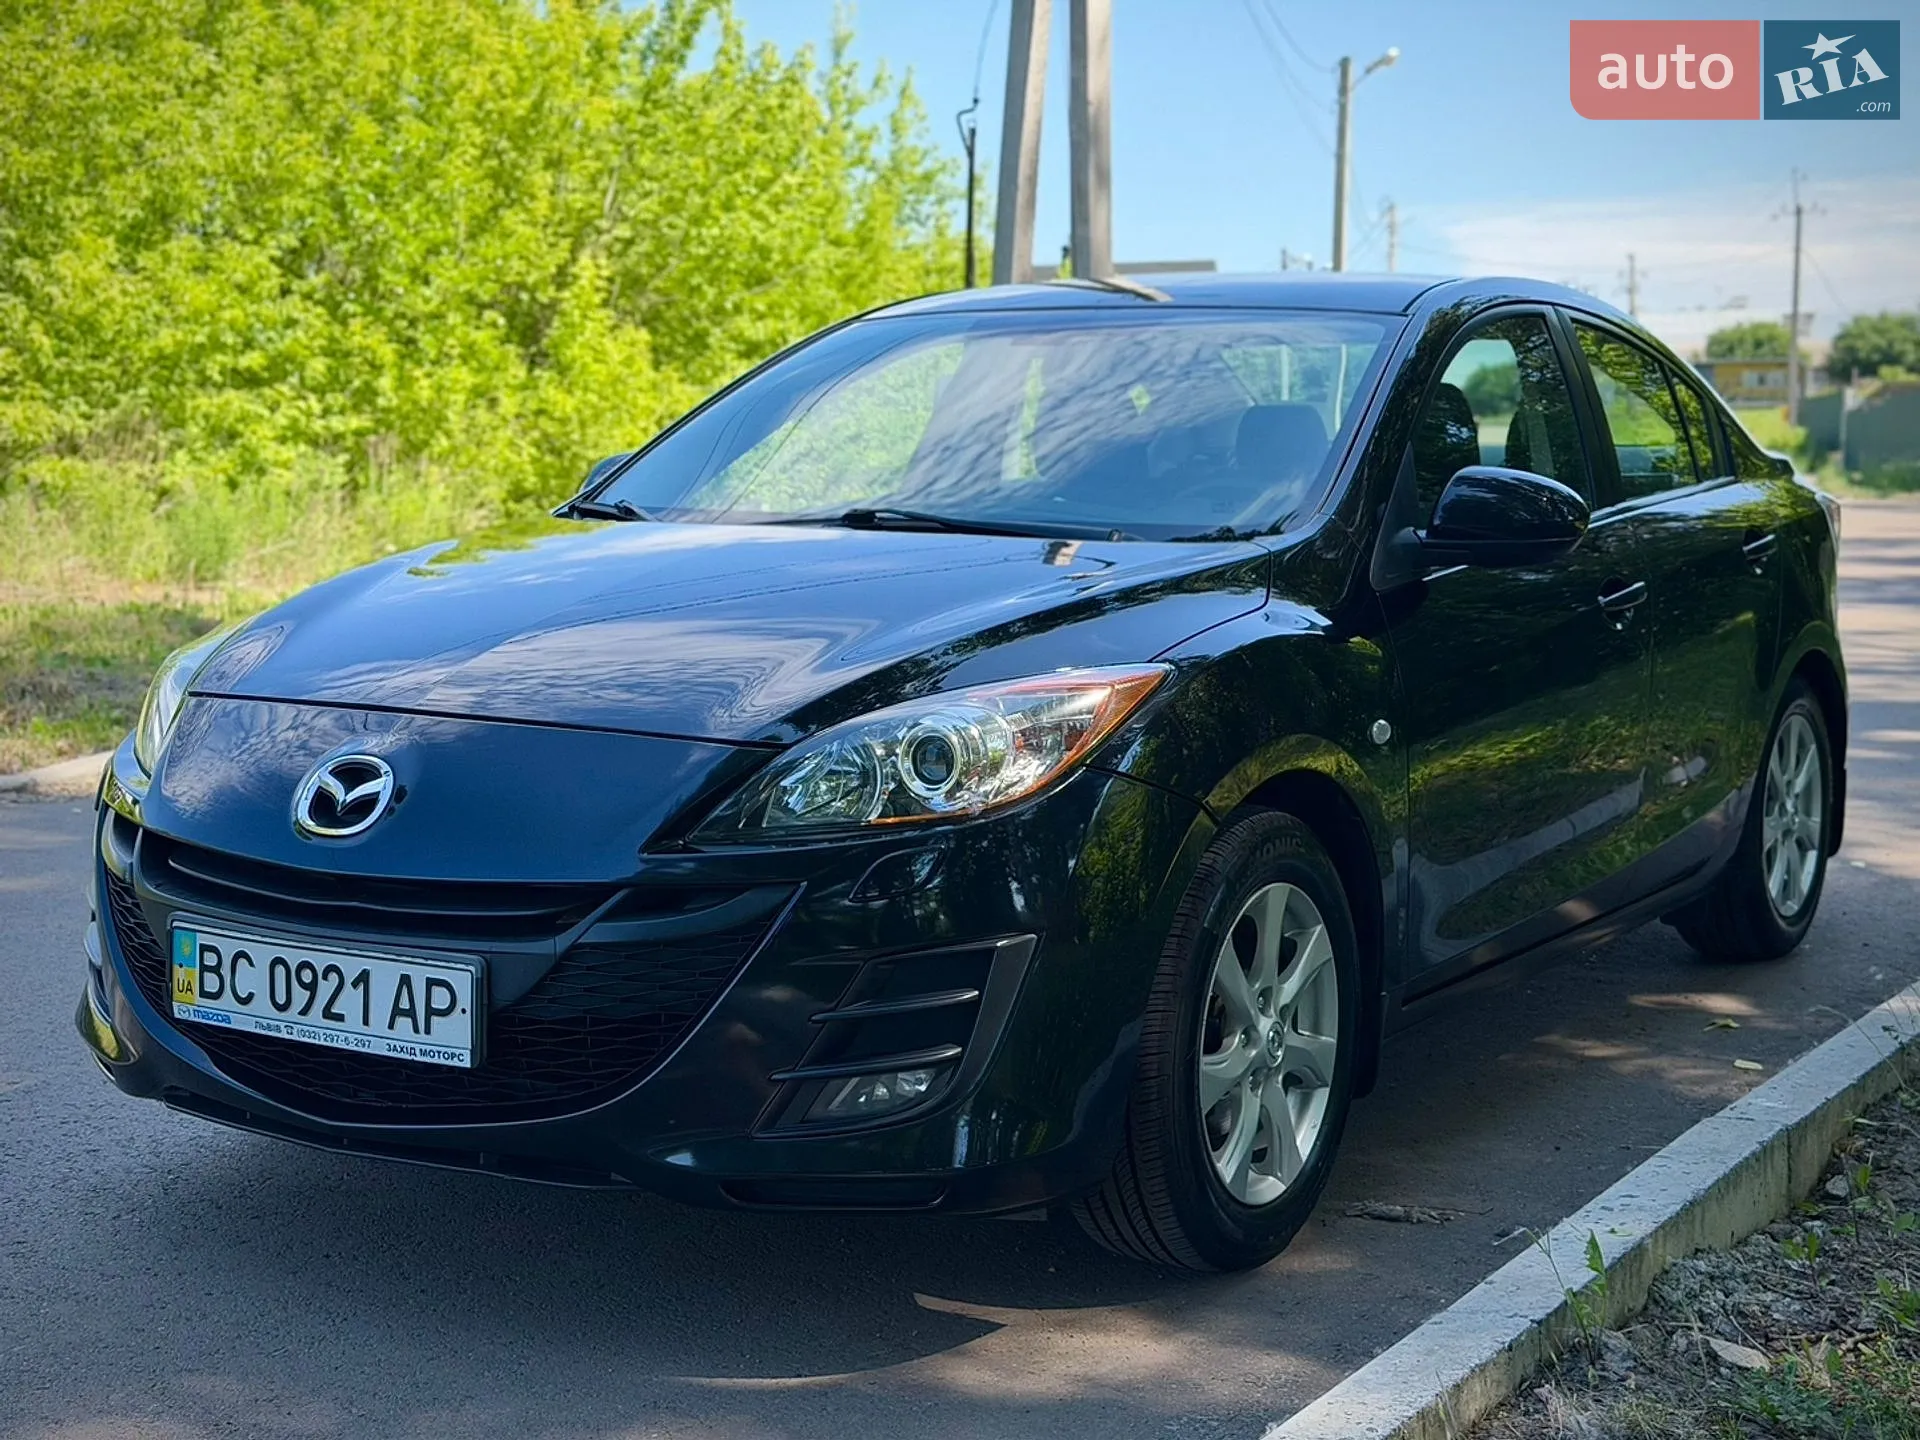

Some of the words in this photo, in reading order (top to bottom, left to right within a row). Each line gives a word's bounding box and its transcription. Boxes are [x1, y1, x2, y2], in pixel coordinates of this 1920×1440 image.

[176, 978, 194, 996] UA
[198, 942, 256, 1006] BC
[268, 955, 371, 1027] 0921
[386, 972, 458, 1035] AP
[193, 1008, 232, 1025] mazda
[296, 1028, 321, 1042] (032)
[323, 1033, 372, 1049] 297-6-297
[385, 1042, 418, 1058] ЗАХІД
[419, 1048, 465, 1063] МОТОРС
